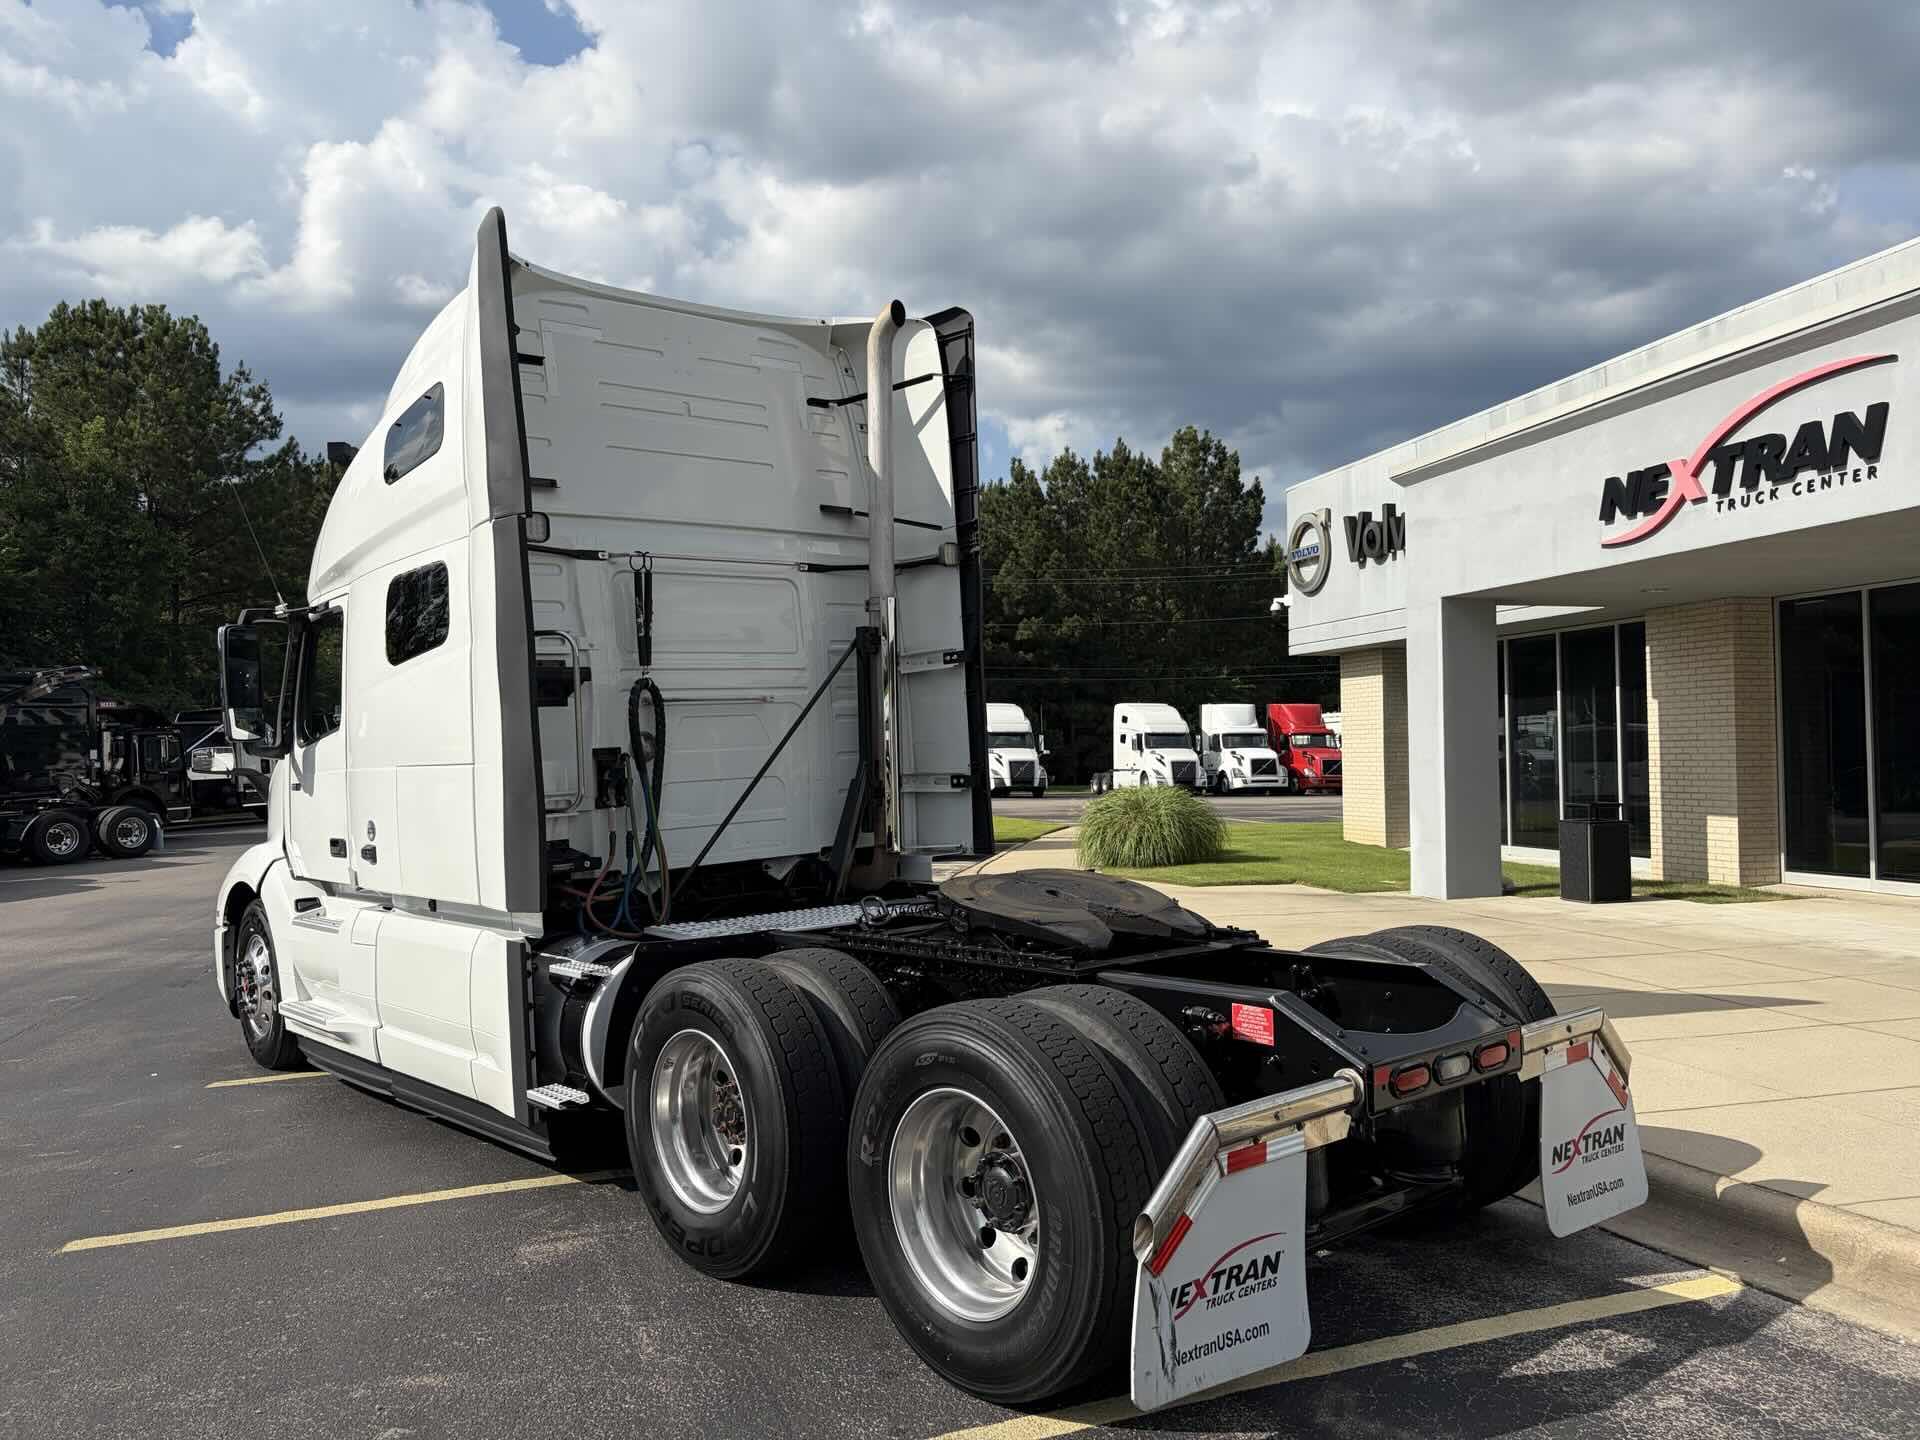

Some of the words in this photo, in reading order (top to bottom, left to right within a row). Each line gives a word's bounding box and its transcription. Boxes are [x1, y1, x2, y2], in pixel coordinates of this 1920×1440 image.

[1599, 400, 1890, 526] NEXTRAN
[1715, 487, 1779, 513] TRUCK
[1792, 465, 1879, 496] CENTER
[1291, 545, 1319, 561] VOLVO
[1552, 1123, 1625, 1166] NEXTRAN
[1581, 1152, 1600, 1165] TRUCK
[1600, 1143, 1625, 1159] CENTERS
[1567, 1178, 1625, 1207] NextranUSA.com
[1206, 1290, 1235, 1310] TRUCK
[1238, 1276, 1278, 1299] CENTERS
